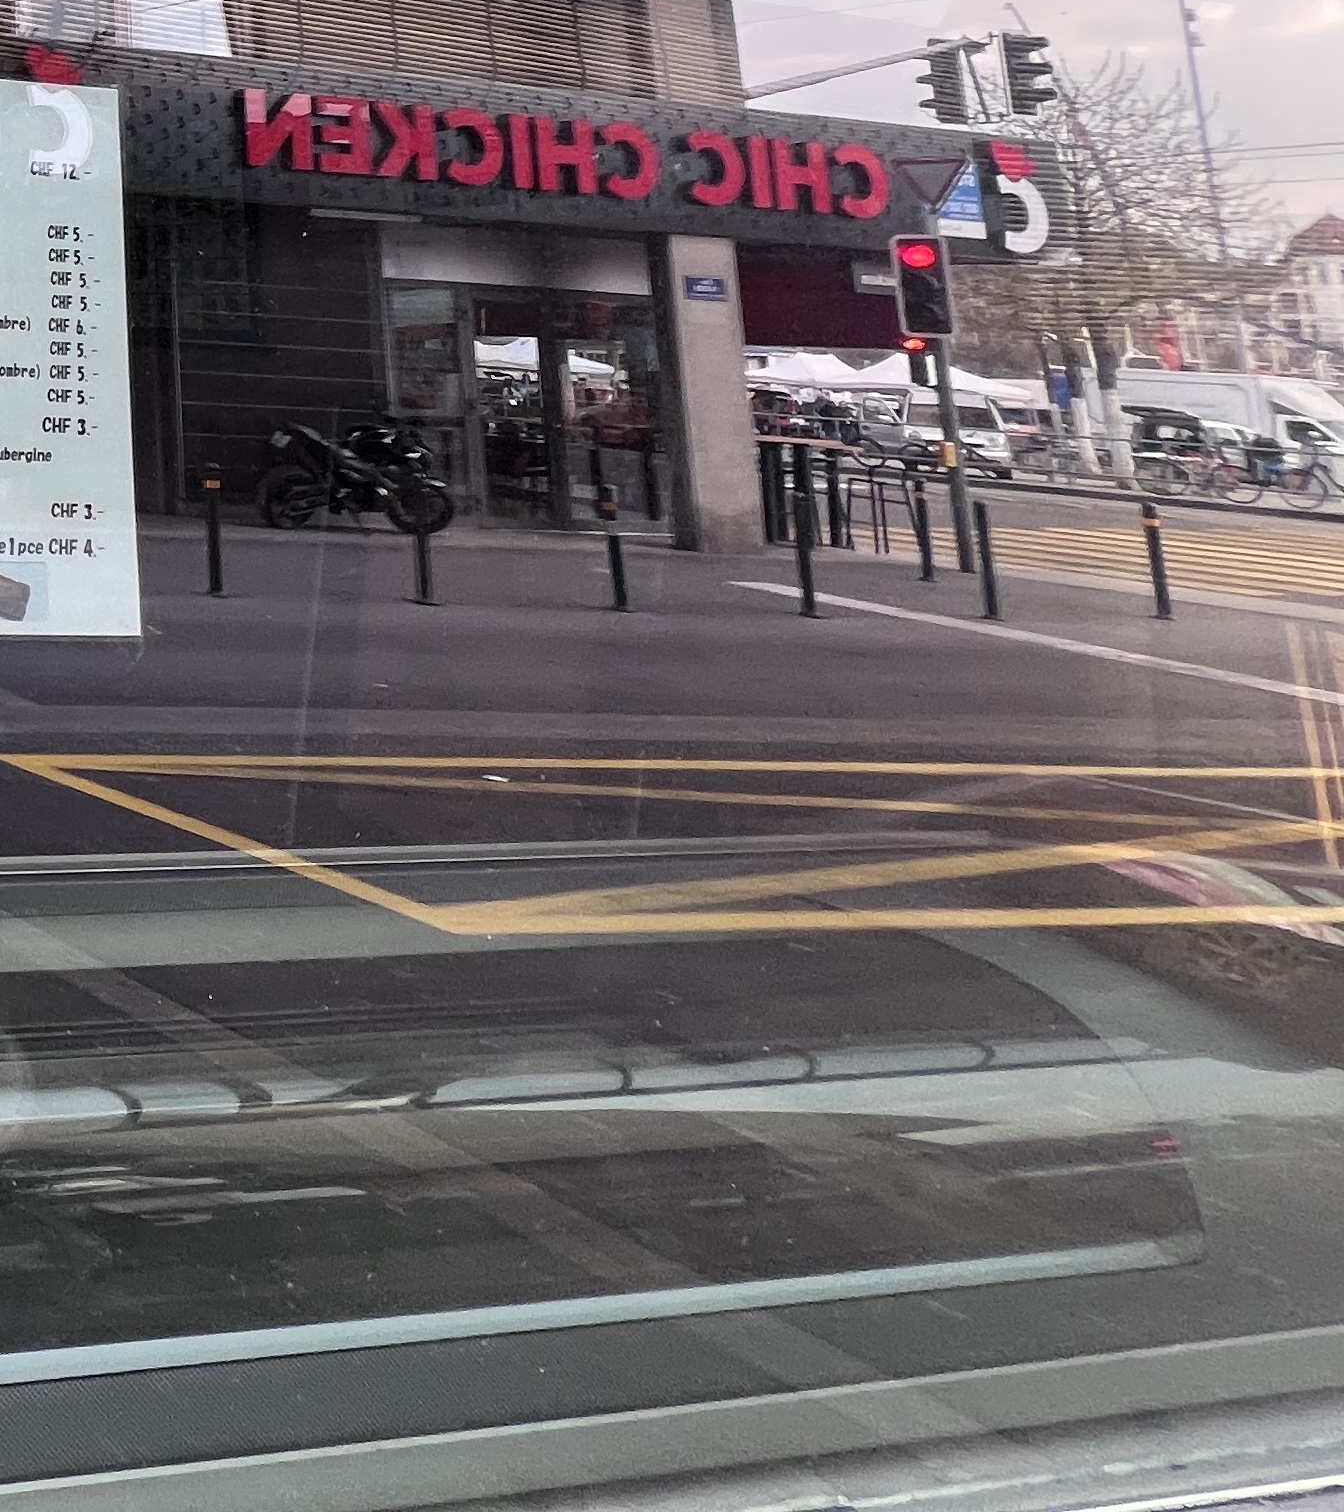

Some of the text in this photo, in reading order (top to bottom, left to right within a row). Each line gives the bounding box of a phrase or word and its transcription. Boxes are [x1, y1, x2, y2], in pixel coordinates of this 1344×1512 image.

[47, 225, 69, 240] CHF
[48, 248, 70, 263] CHF
[50, 271, 72, 286] CHF
[51, 295, 73, 310] CHF
[48, 318, 70, 333] CHF
[50, 341, 72, 356] CHF
[49, 365, 71, 380] CHF
[47, 389, 72, 403] CHF
[42, 417, 71, 434] CHF
[51, 502, 79, 518] CHF
[48, 539, 79, 555] CHF
